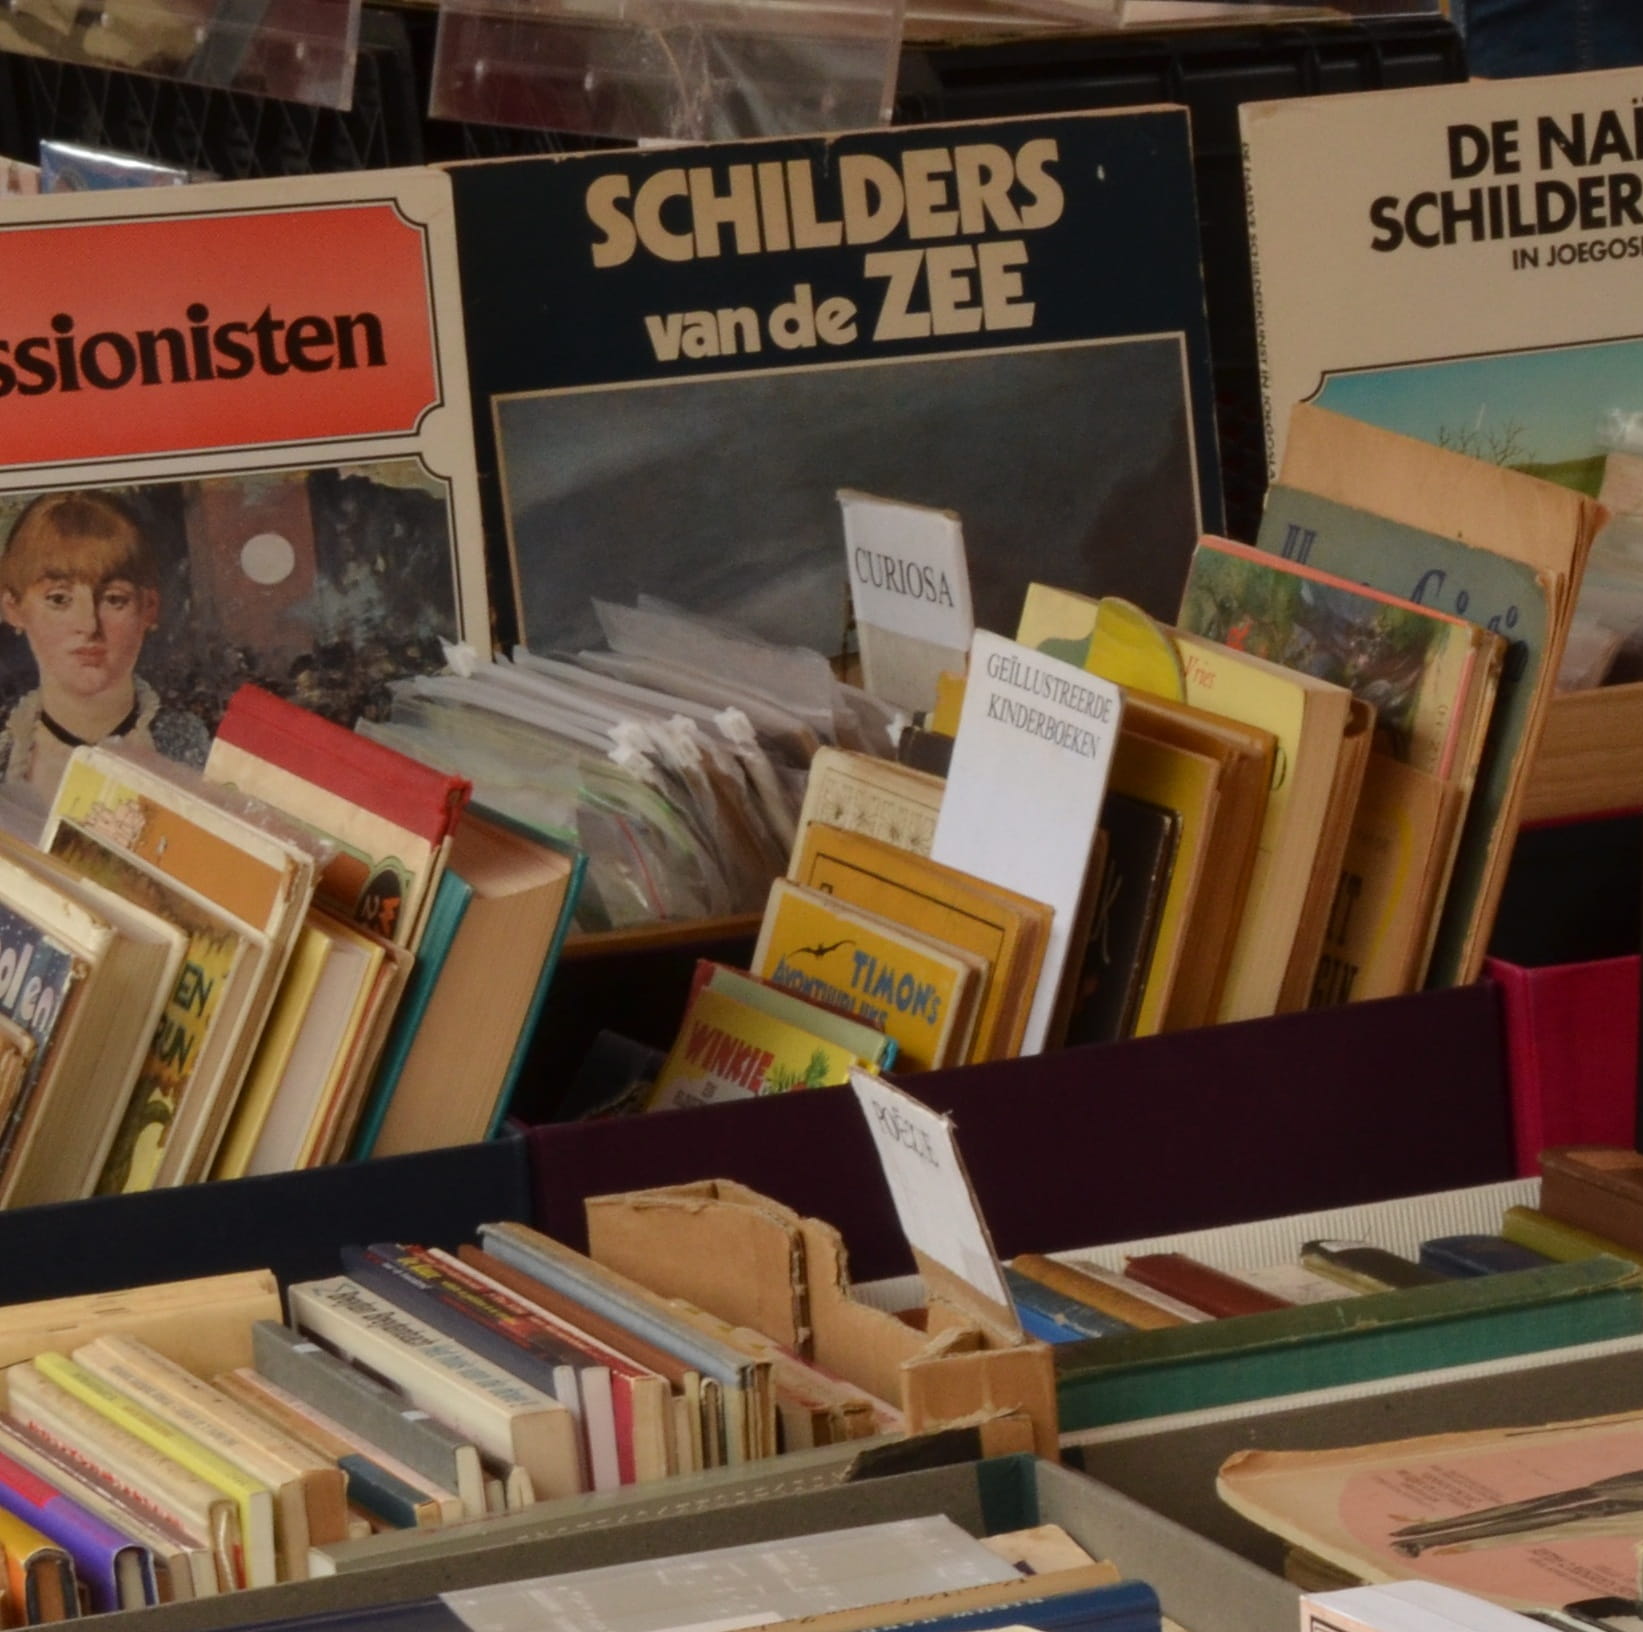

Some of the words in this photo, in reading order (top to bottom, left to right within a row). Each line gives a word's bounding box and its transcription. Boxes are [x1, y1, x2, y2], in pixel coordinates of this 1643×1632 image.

[1447, 120, 1519, 180] DE
[586, 139, 1064, 268] SCHILDERS
[1511, 246, 1539, 270] IN
[645, 307, 760, 361] van
[769, 284, 856, 350] de
[864, 241, 1036, 342] ZEE
[854, 547, 955, 608] CURIOSA
[987, 652, 1112, 724] GEÏLLUSTREERDE
[987, 694, 1100, 760] KINDERBOEKEN
